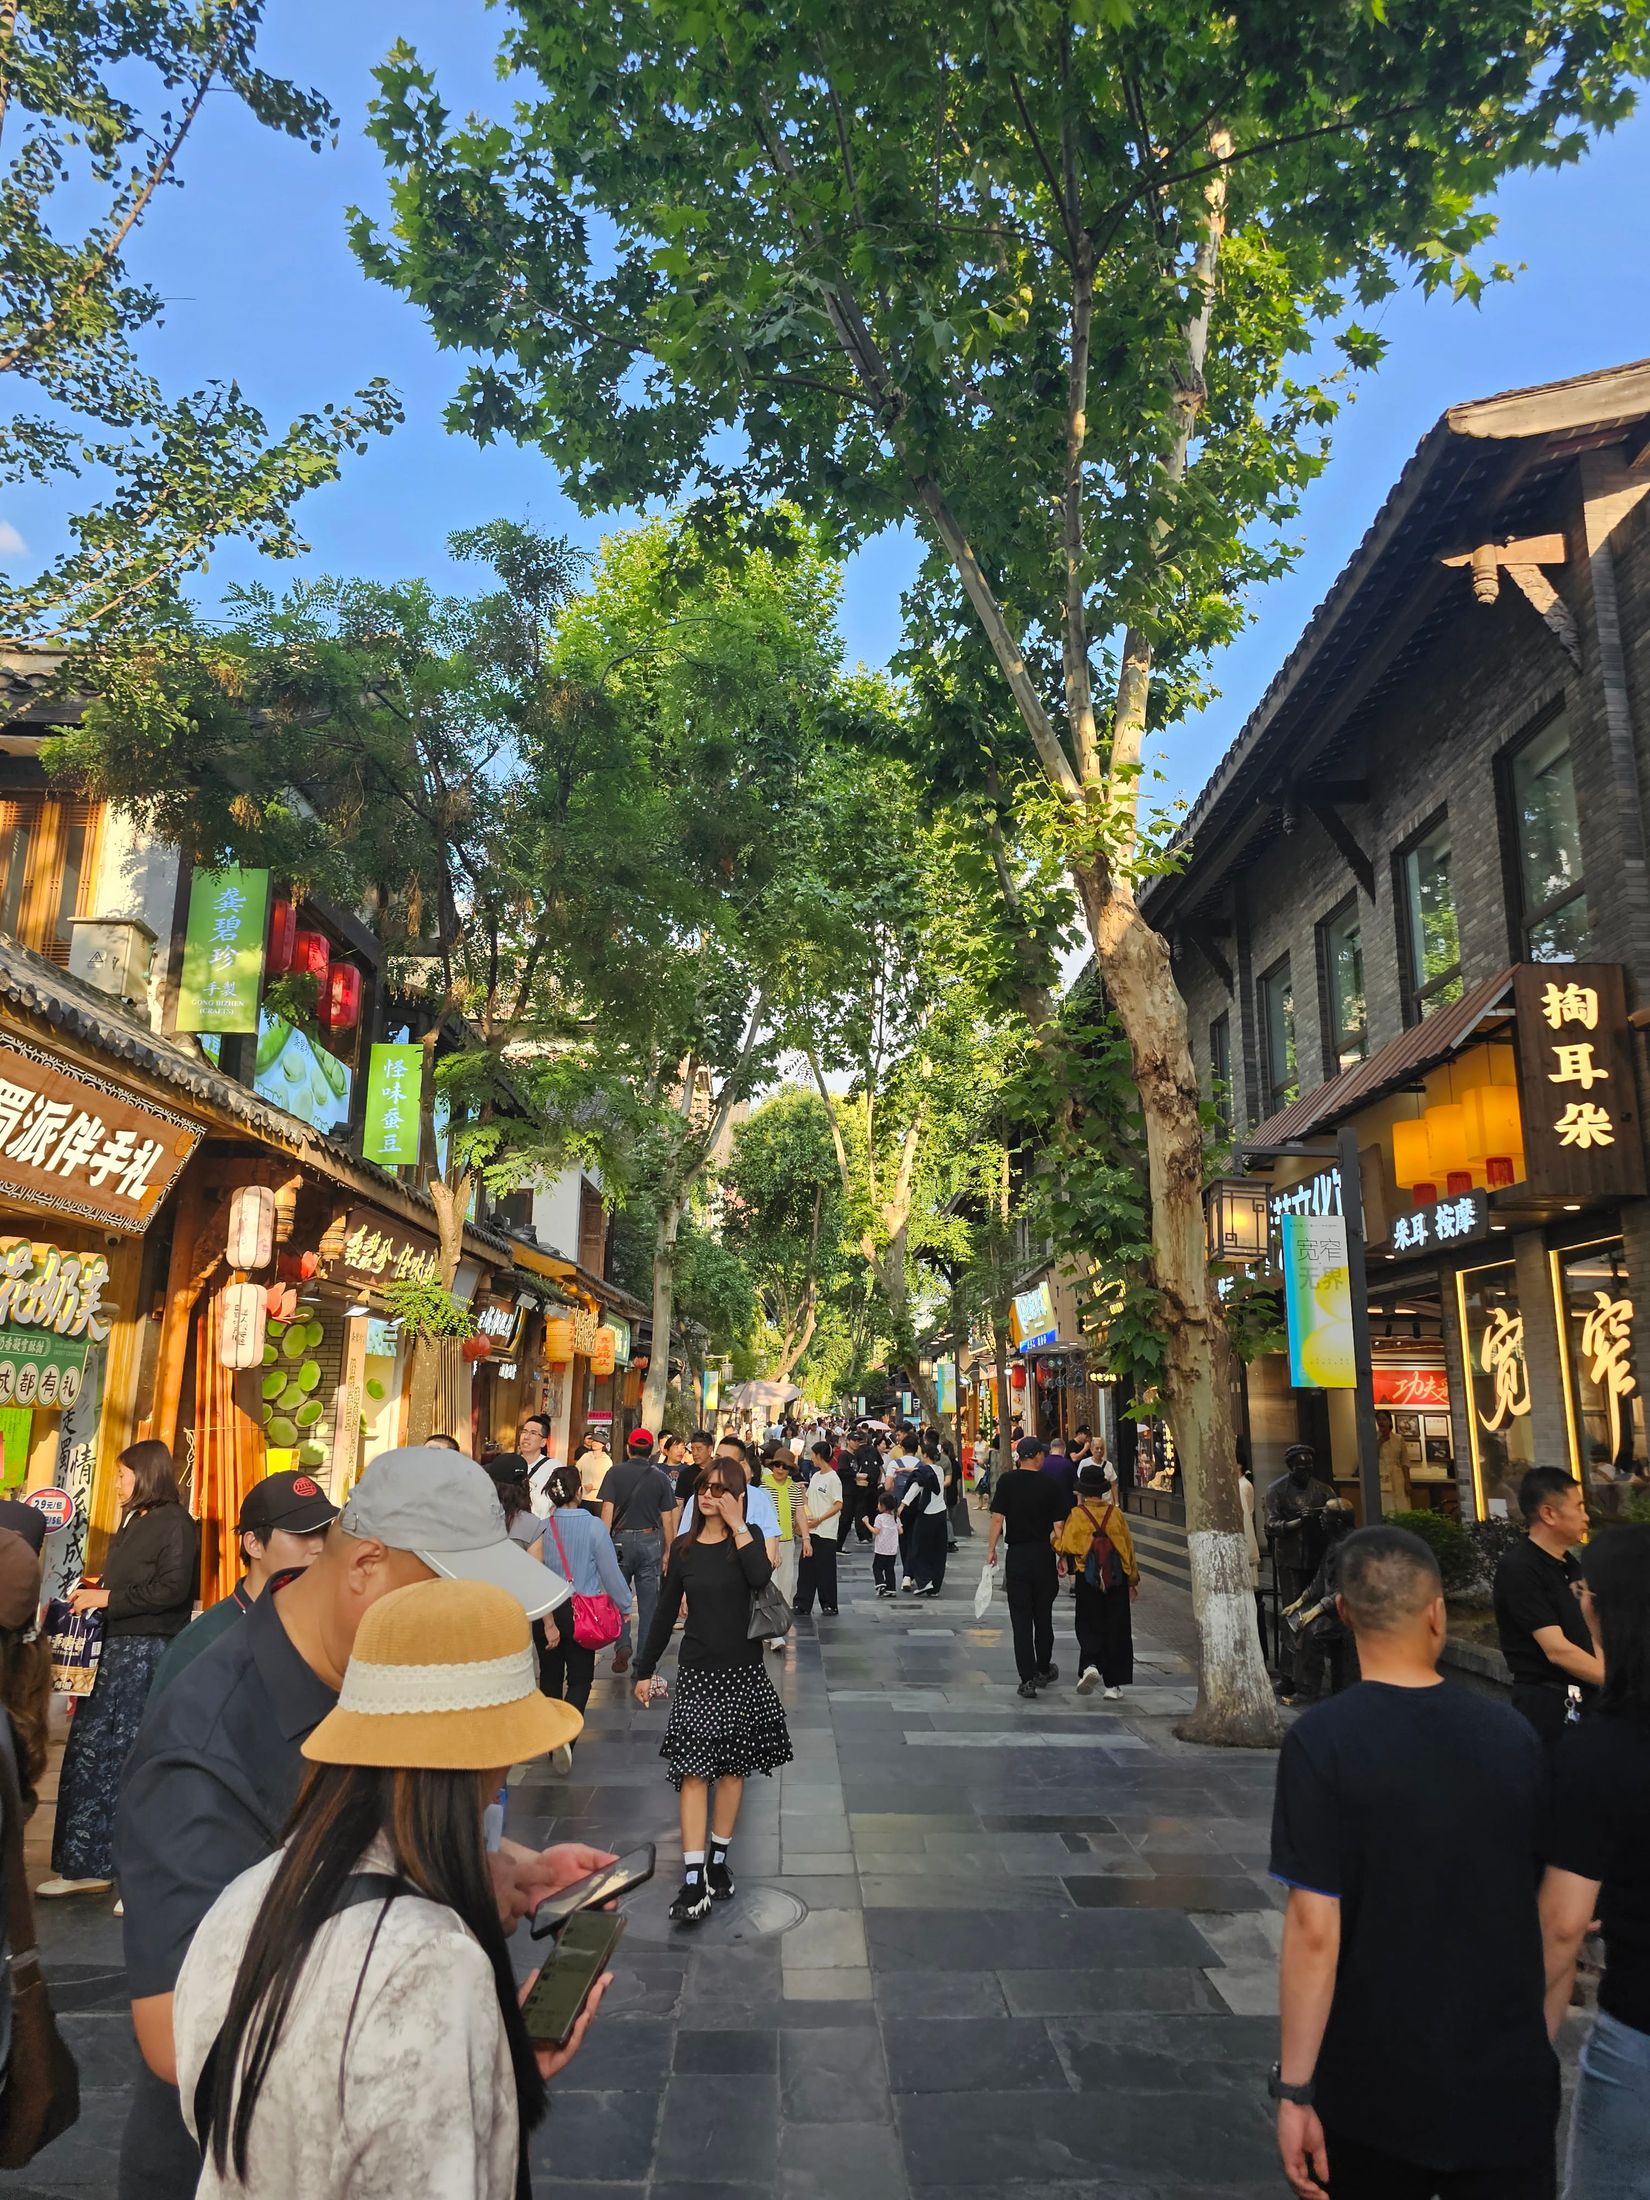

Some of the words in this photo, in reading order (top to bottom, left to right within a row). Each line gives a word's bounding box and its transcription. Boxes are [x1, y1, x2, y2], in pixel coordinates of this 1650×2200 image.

[207, 886, 249, 972] 龚碧珍
[1540, 982, 1616, 1149] 掏耳朵
[376, 1057, 409, 1154] 怪味蚕豆
[1296, 1237, 1343, 1263] 宽窄
[1392, 1211, 1429, 1252] 采耳
[1433, 1197, 1477, 1241] 按摩
[1298, 1266, 1345, 1291] 无界
[0, 1369, 76, 1398] 成都有礼
